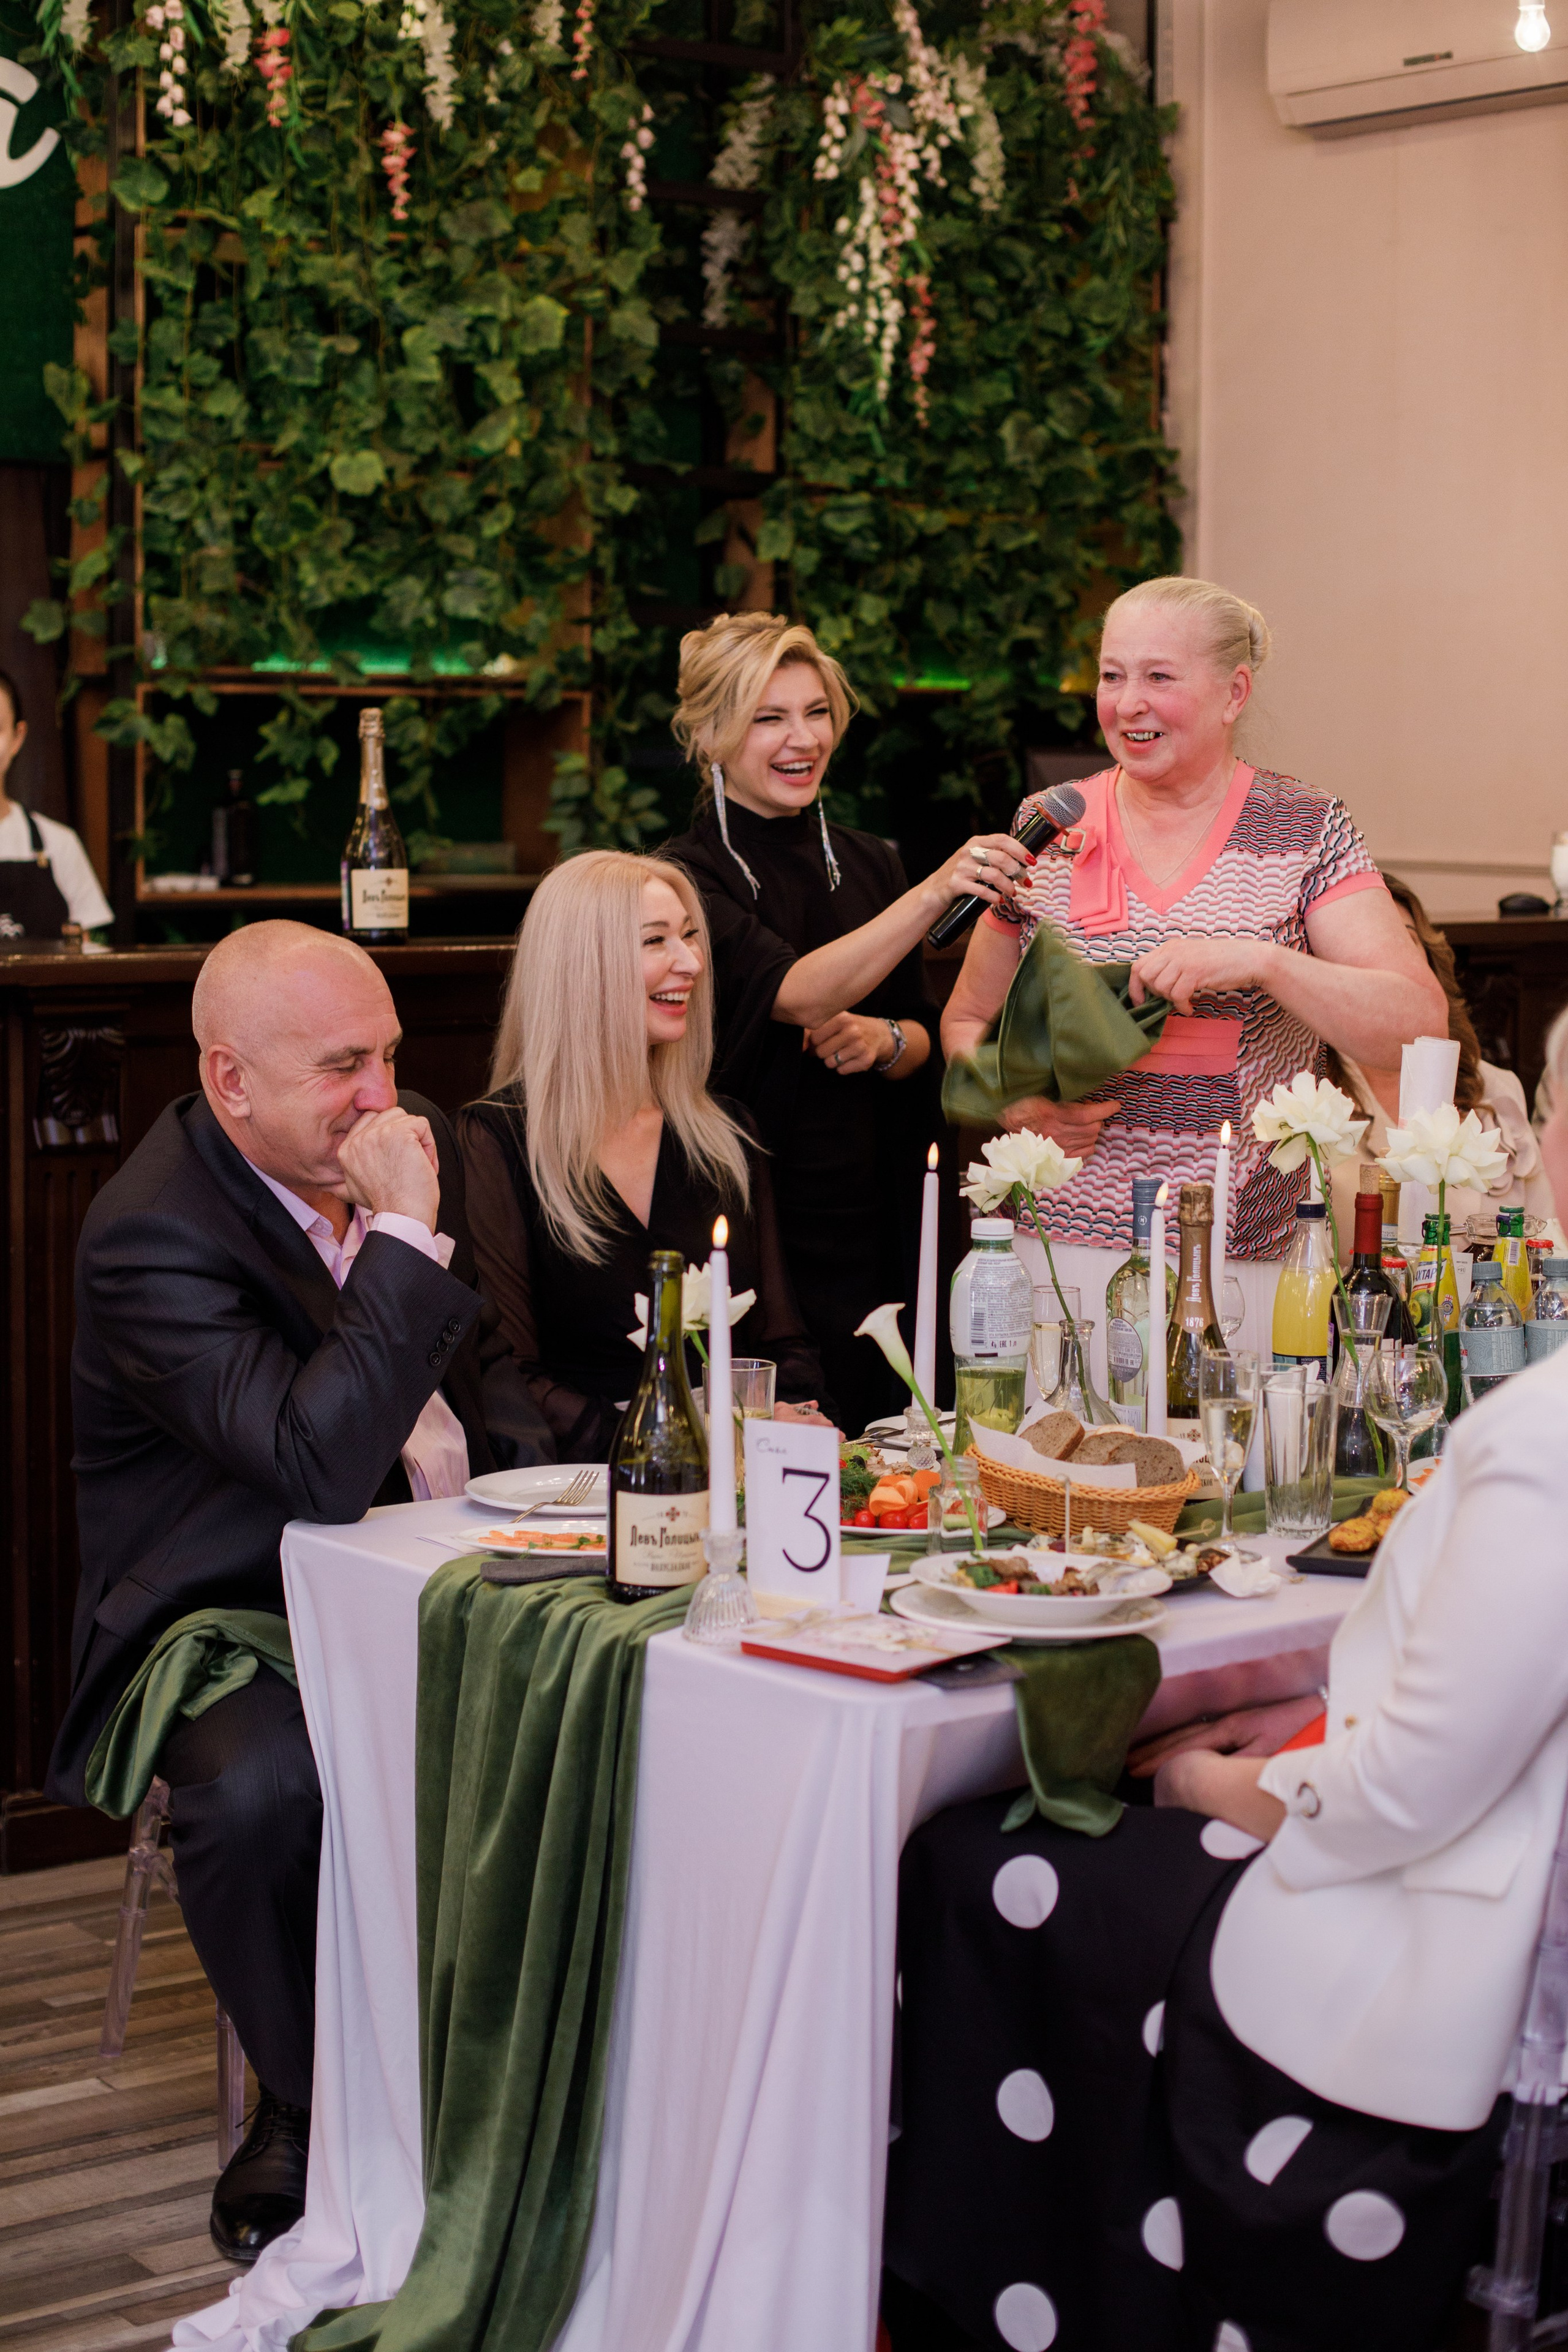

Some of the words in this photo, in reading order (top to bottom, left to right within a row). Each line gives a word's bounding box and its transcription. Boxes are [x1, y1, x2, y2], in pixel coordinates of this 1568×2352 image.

[630, 1525, 657, 1547] Левъ
[660, 1526, 700, 1548] Голицын
[782, 1466, 832, 1573] 3
